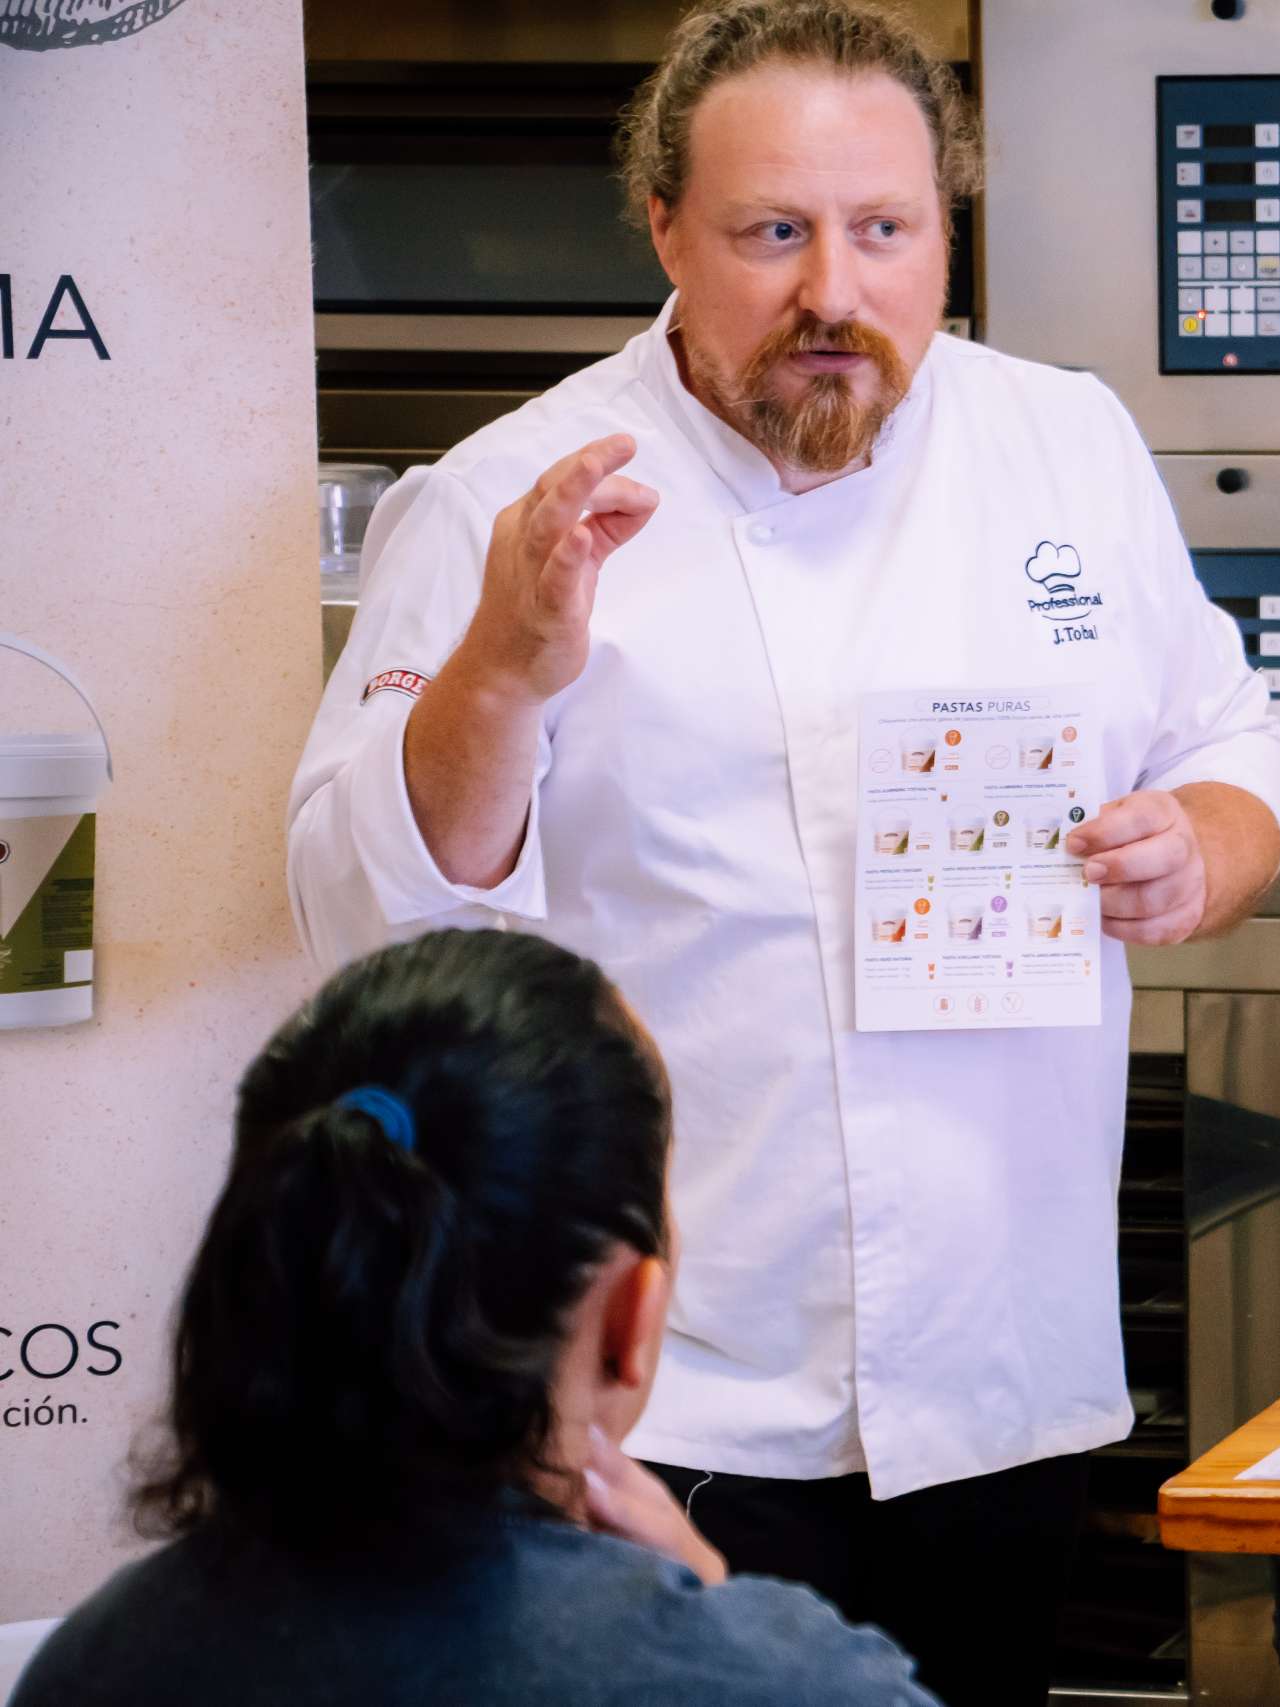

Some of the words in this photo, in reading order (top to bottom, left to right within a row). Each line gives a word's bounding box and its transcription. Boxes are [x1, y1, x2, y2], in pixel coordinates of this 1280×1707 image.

[0, 274, 111, 361] A
[1028, 592, 1103, 612] Professional
[932, 701, 983, 713] PASTAS
[987, 699, 1031, 712] PURAS
[3, 1395, 88, 1428] ción.
